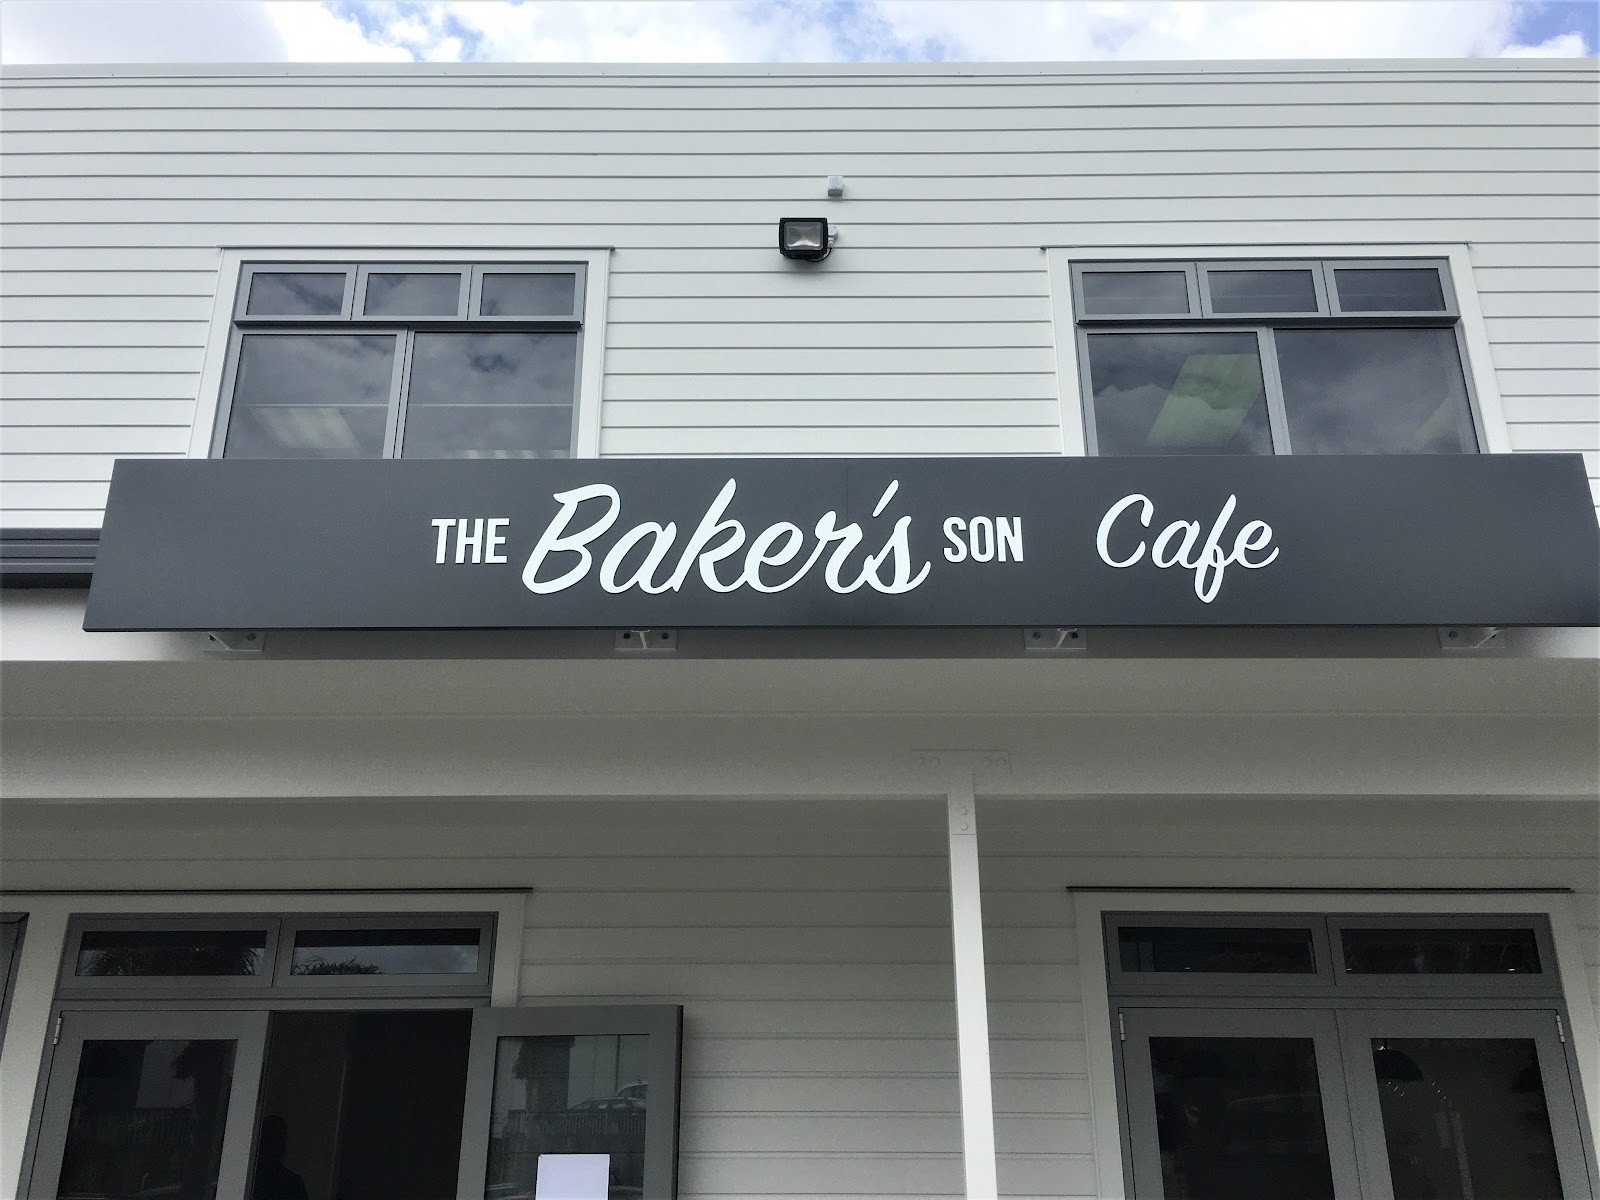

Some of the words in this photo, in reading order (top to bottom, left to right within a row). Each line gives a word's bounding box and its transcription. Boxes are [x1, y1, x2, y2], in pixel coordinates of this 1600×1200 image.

[431, 517, 510, 565] THE
[521, 477, 932, 595] Baker's
[942, 515, 1024, 563] SON
[1096, 493, 1280, 604] Cafe
